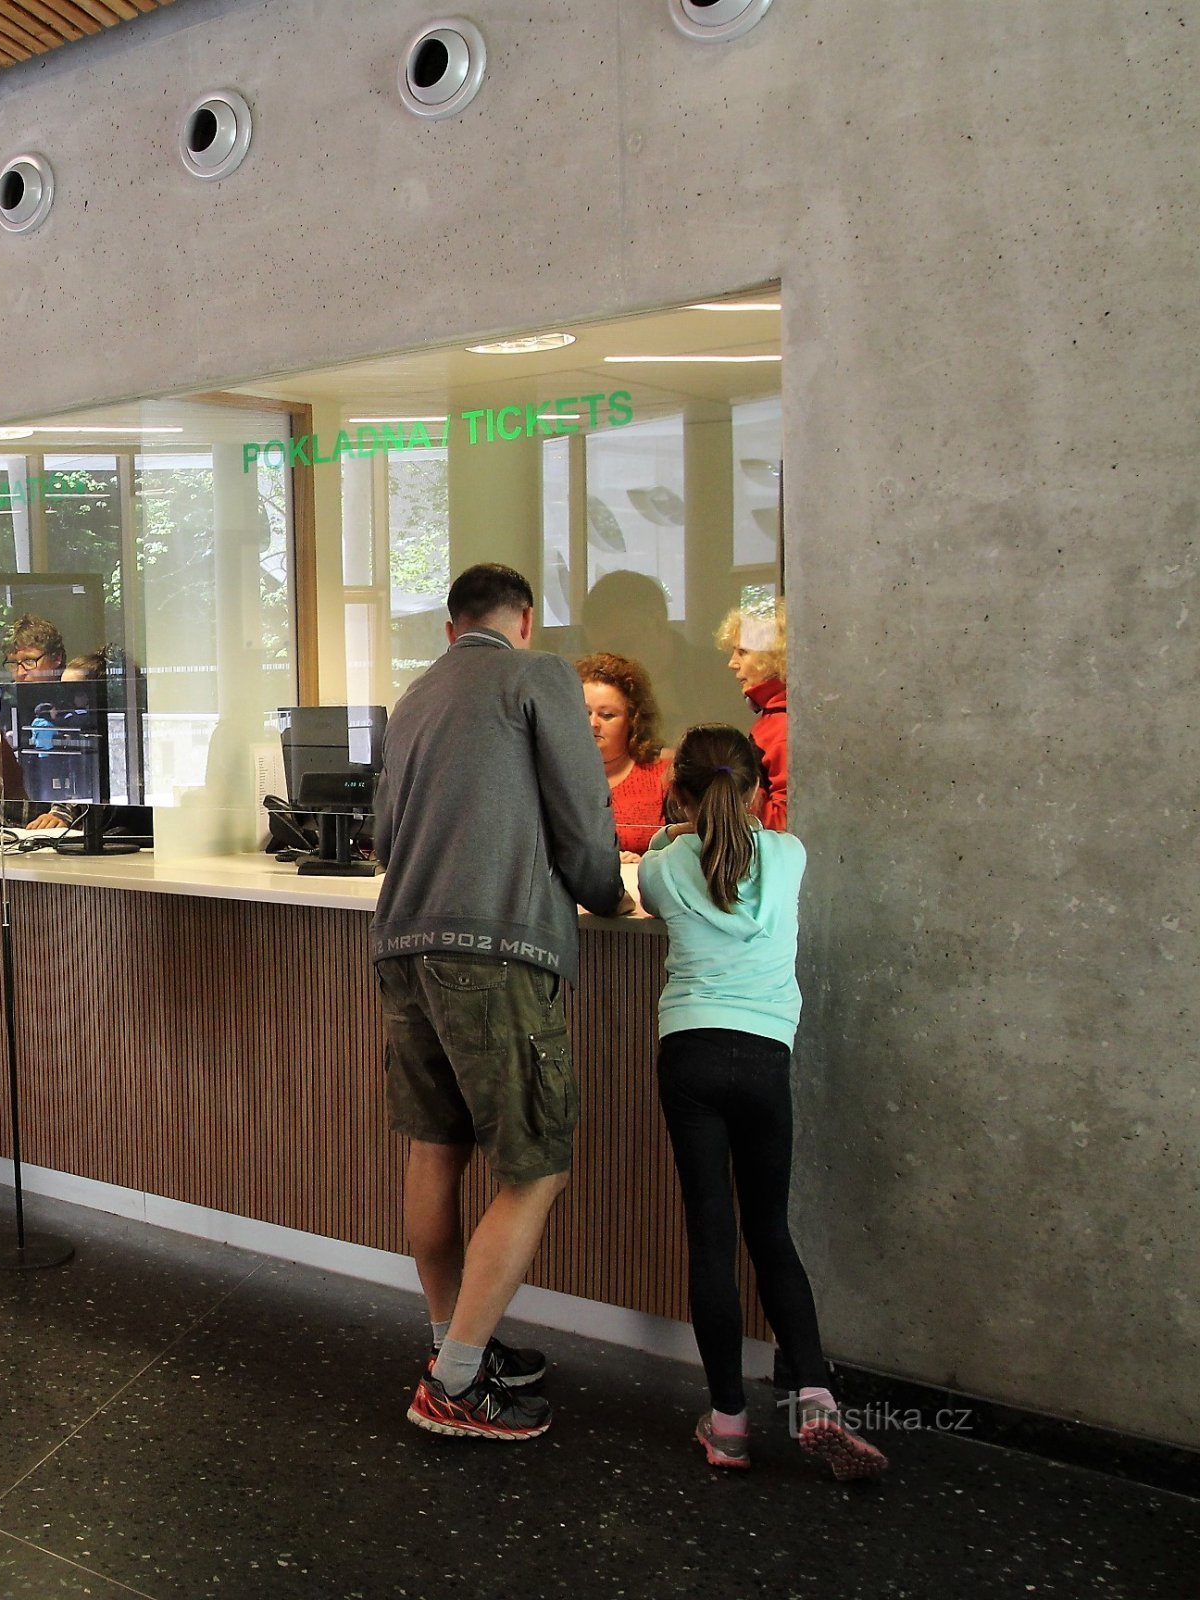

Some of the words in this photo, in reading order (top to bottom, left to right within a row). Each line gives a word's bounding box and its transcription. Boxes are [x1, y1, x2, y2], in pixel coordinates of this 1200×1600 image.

[243, 421, 431, 473] POKLADNA
[441, 415, 451, 448] /
[461, 390, 635, 445] TICKETS
[387, 931, 435, 951] MRTN
[441, 931, 492, 950] 902
[499, 938, 560, 967] MRTN
